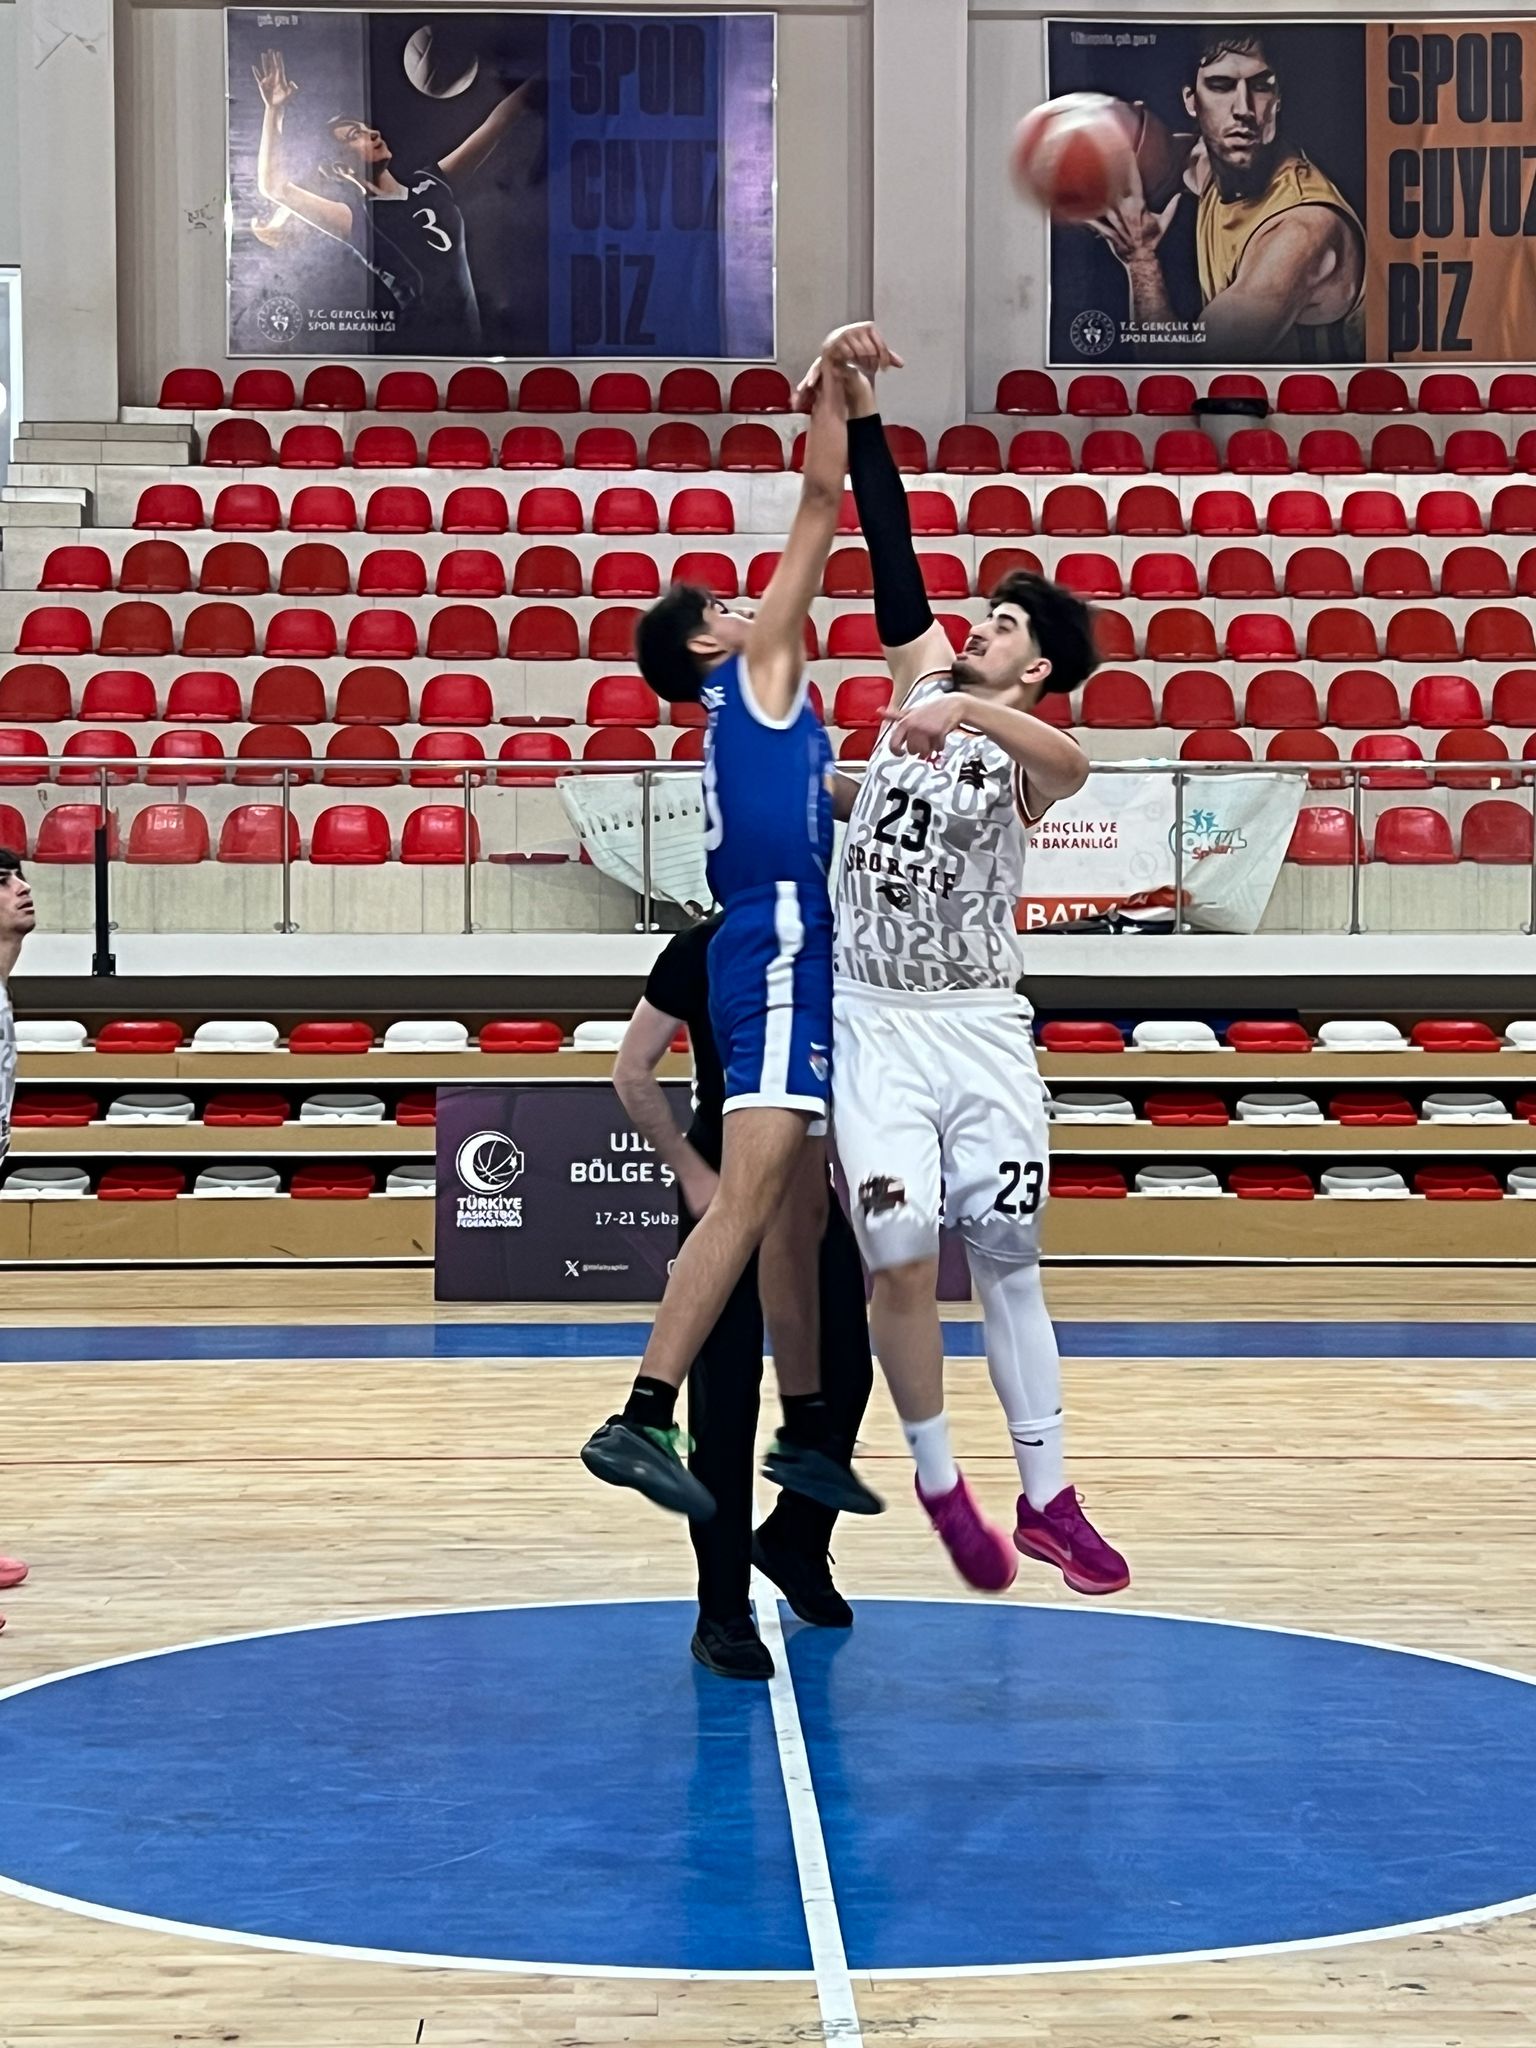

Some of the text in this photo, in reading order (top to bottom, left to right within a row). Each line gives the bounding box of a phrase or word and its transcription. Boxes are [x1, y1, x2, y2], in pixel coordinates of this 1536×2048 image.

[569, 24, 705, 116] SPOR
[1388, 32, 1523, 125] SPOR
[411, 207, 453, 253] 3
[570, 243, 656, 346] BİZ
[1388, 251, 1473, 353] BİZ
[330, 309, 378, 320] GENÇLİK
[381, 310, 396, 319] VE
[308, 320, 396, 332] SPOR BAKANLIĞI
[1141, 320, 1189, 332] GENÇLİK
[1192, 322, 1206, 331] VE
[1120, 333, 1207, 343] SPOR BAKANLIĞI
[873, 787, 932, 852] 23
[1099, 822, 1118, 833] VE
[1042, 836, 1118, 849] BAKANLIĞI
[570, 1158, 654, 1183] BÖLGE
[994, 1161, 1044, 1214] 23
[457, 1194, 523, 1210] TÜRKİYE
[595, 1211, 679, 1228] 17-21 Şuba
